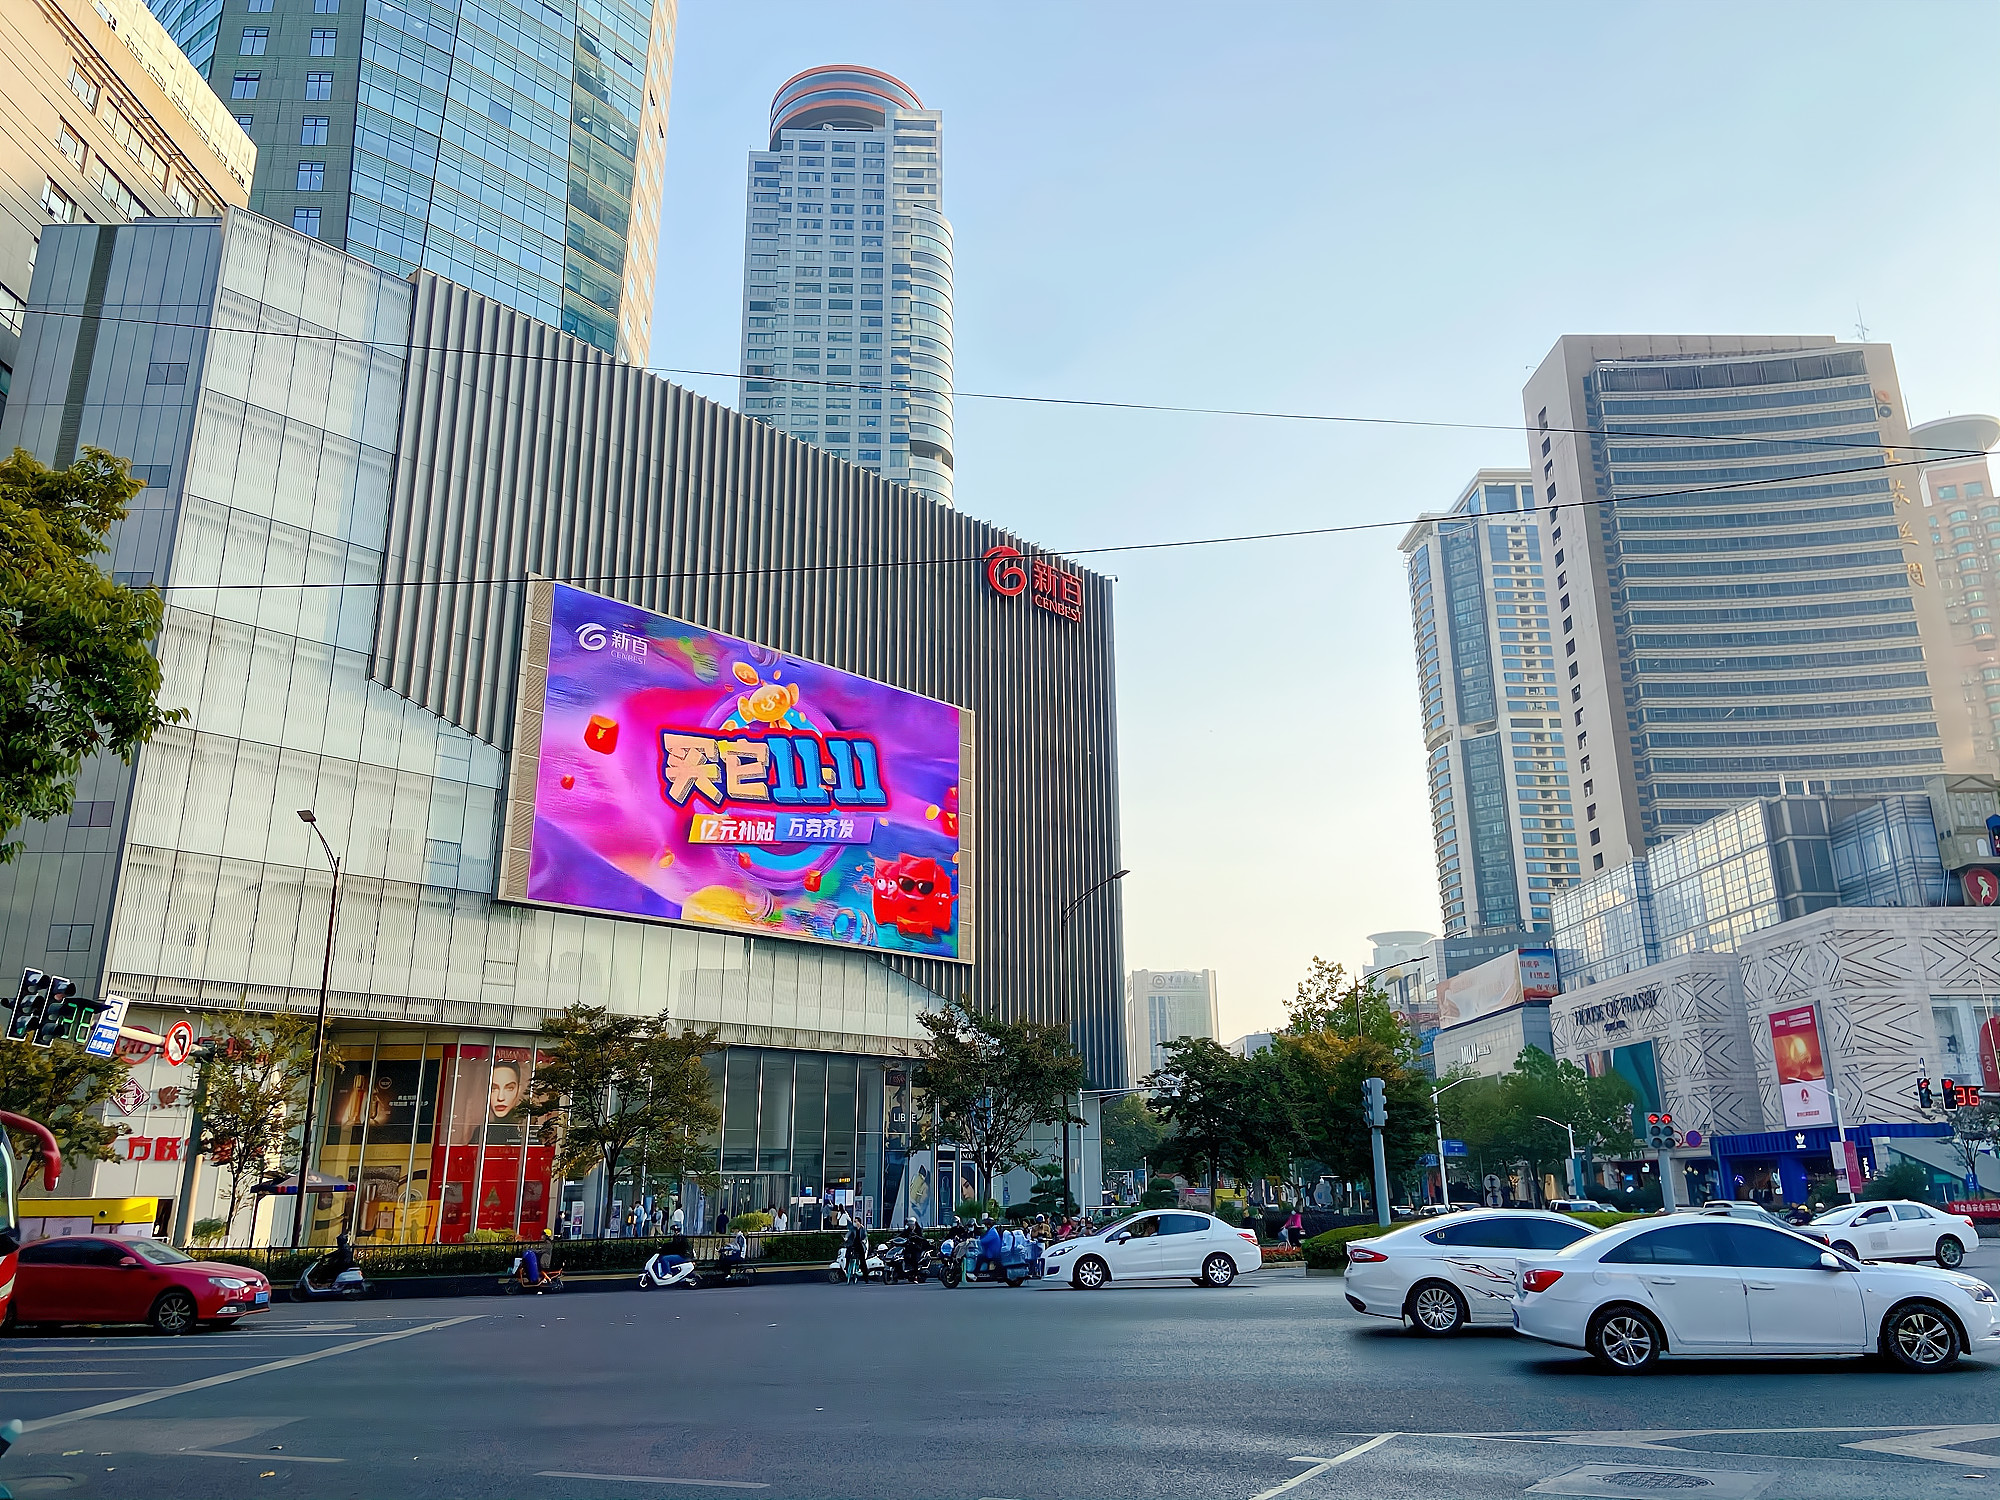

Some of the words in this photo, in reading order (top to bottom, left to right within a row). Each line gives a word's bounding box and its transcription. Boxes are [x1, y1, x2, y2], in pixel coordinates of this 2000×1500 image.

[1033, 559, 1083, 606] 新百
[1034, 594, 1082, 623] CENBEST
[611, 629, 650, 656] 新百
[610, 649, 647, 665] CENBEST
[699, 818, 776, 843] 亿元补贴
[1574, 1004, 1605, 1026] HOUSE
[1955, 1087, 1980, 1106] 36
[893, 1112, 917, 1123] LIBE
